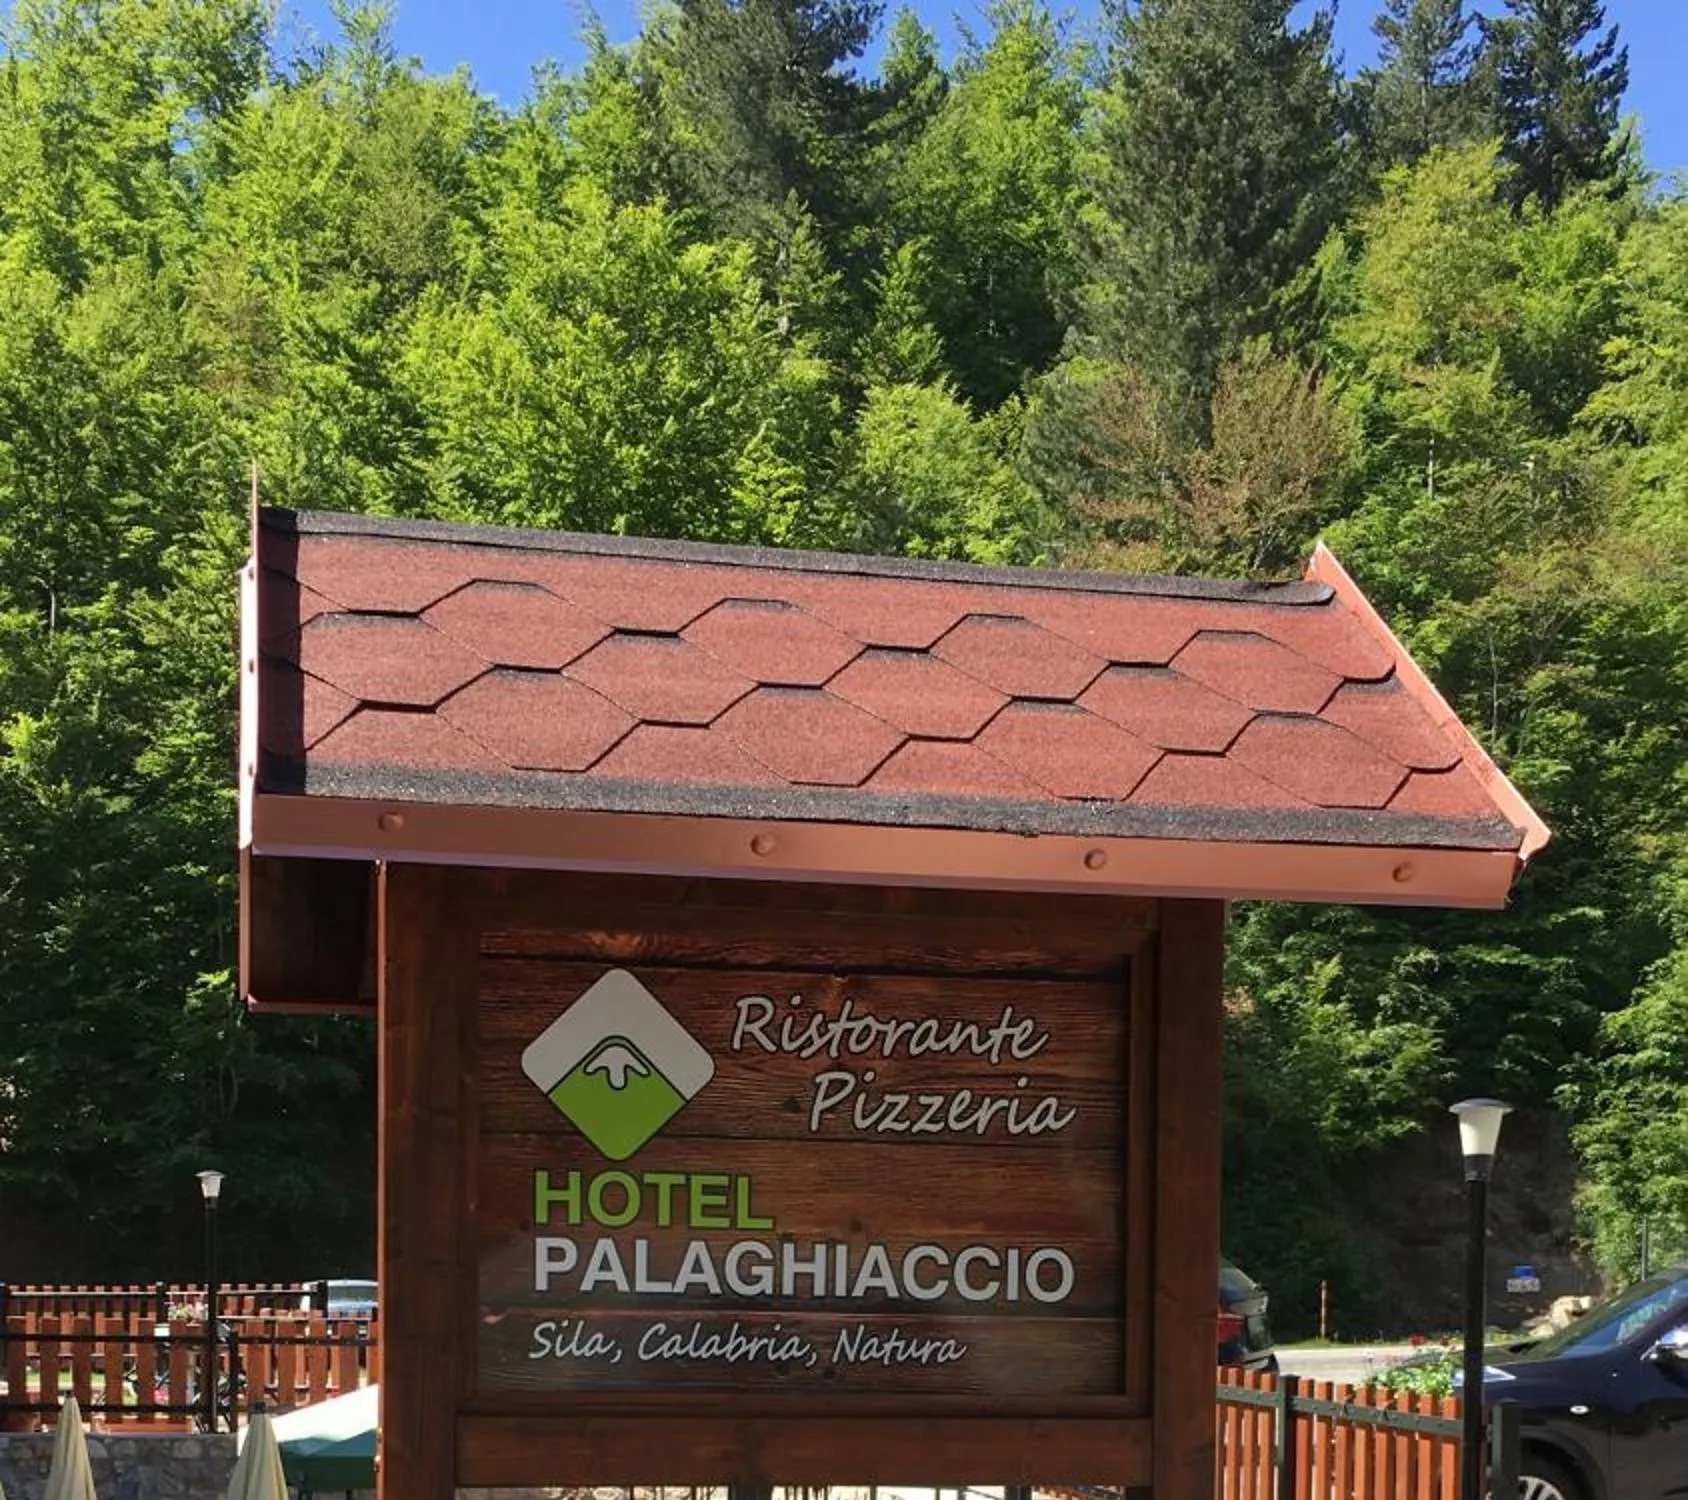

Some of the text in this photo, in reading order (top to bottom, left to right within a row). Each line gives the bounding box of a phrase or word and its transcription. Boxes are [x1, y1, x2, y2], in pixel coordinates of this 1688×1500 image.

[732, 997, 1047, 1062] Ristorante
[810, 1072, 1076, 1135] Pizzeria
[534, 1170, 774, 1228] HOTEL
[534, 1238, 1075, 1302] PALAGHIACCIO
[530, 1321, 966, 1367] Sila, Calabria, Natura
